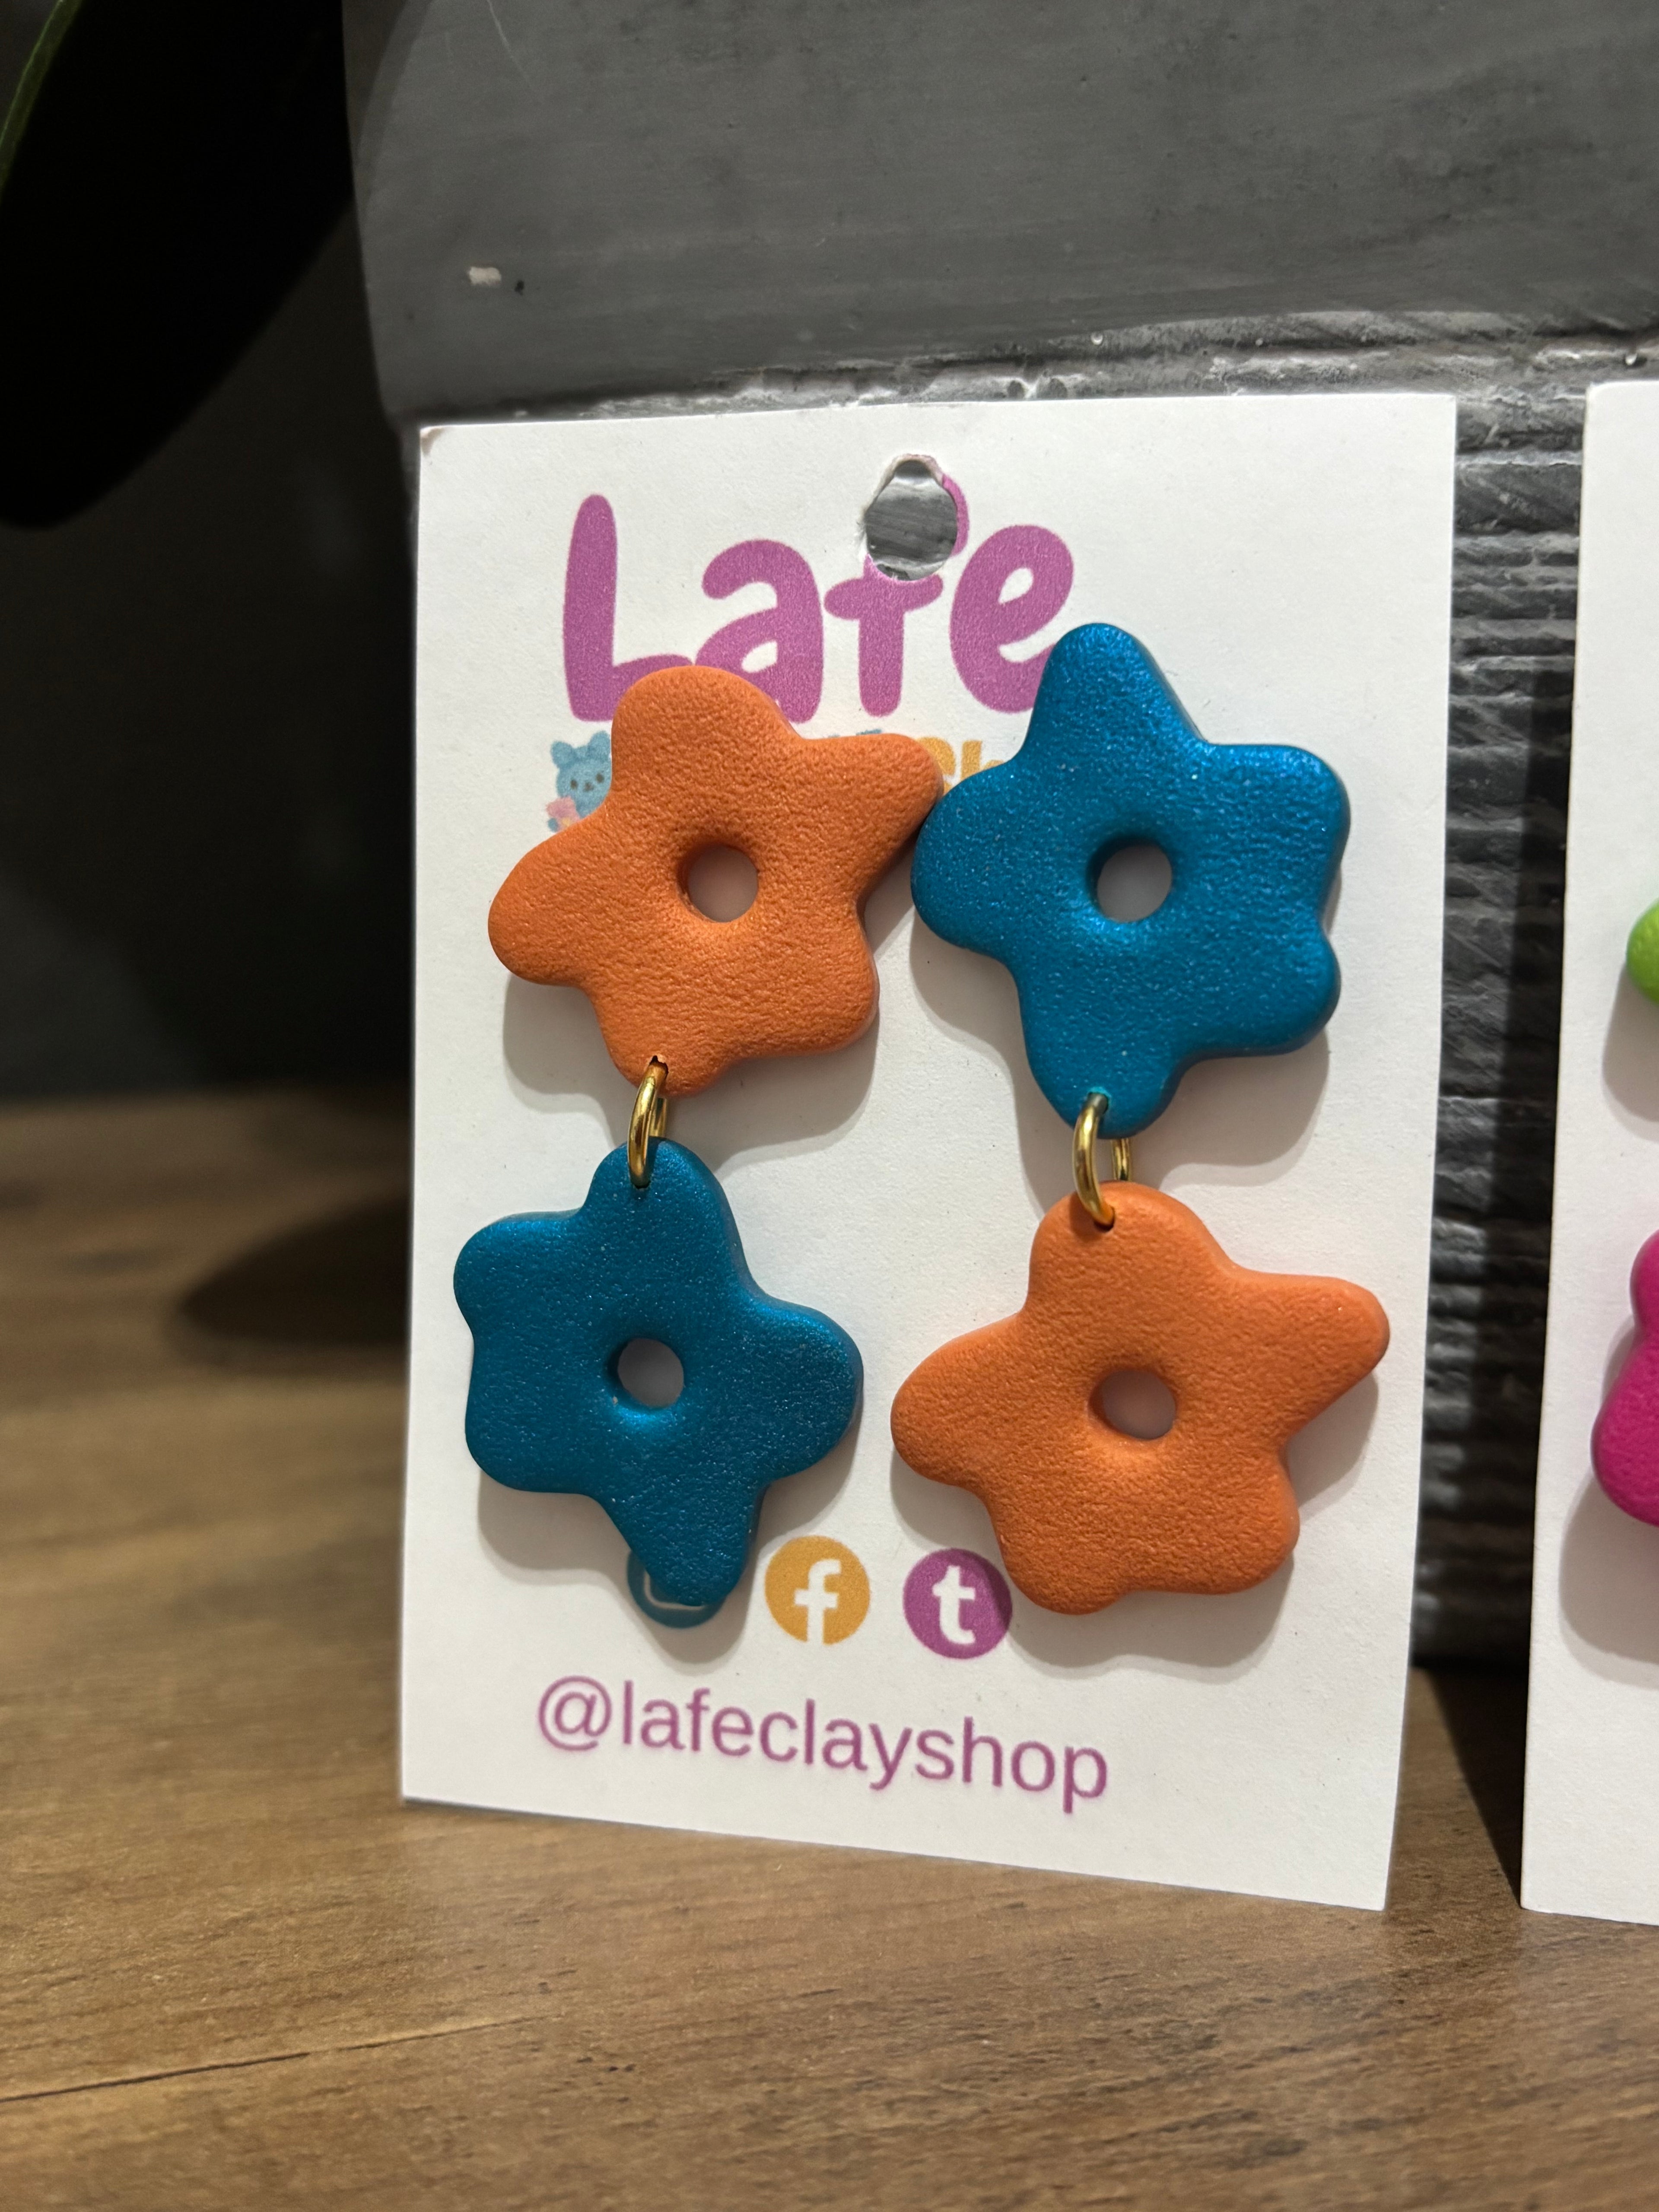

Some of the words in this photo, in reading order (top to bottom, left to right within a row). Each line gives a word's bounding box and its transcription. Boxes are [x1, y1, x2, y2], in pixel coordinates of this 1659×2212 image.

[794, 1558, 842, 1644] f
[932, 1564, 976, 1645] t
[537, 1675, 1108, 1814] @lafeclayshop
